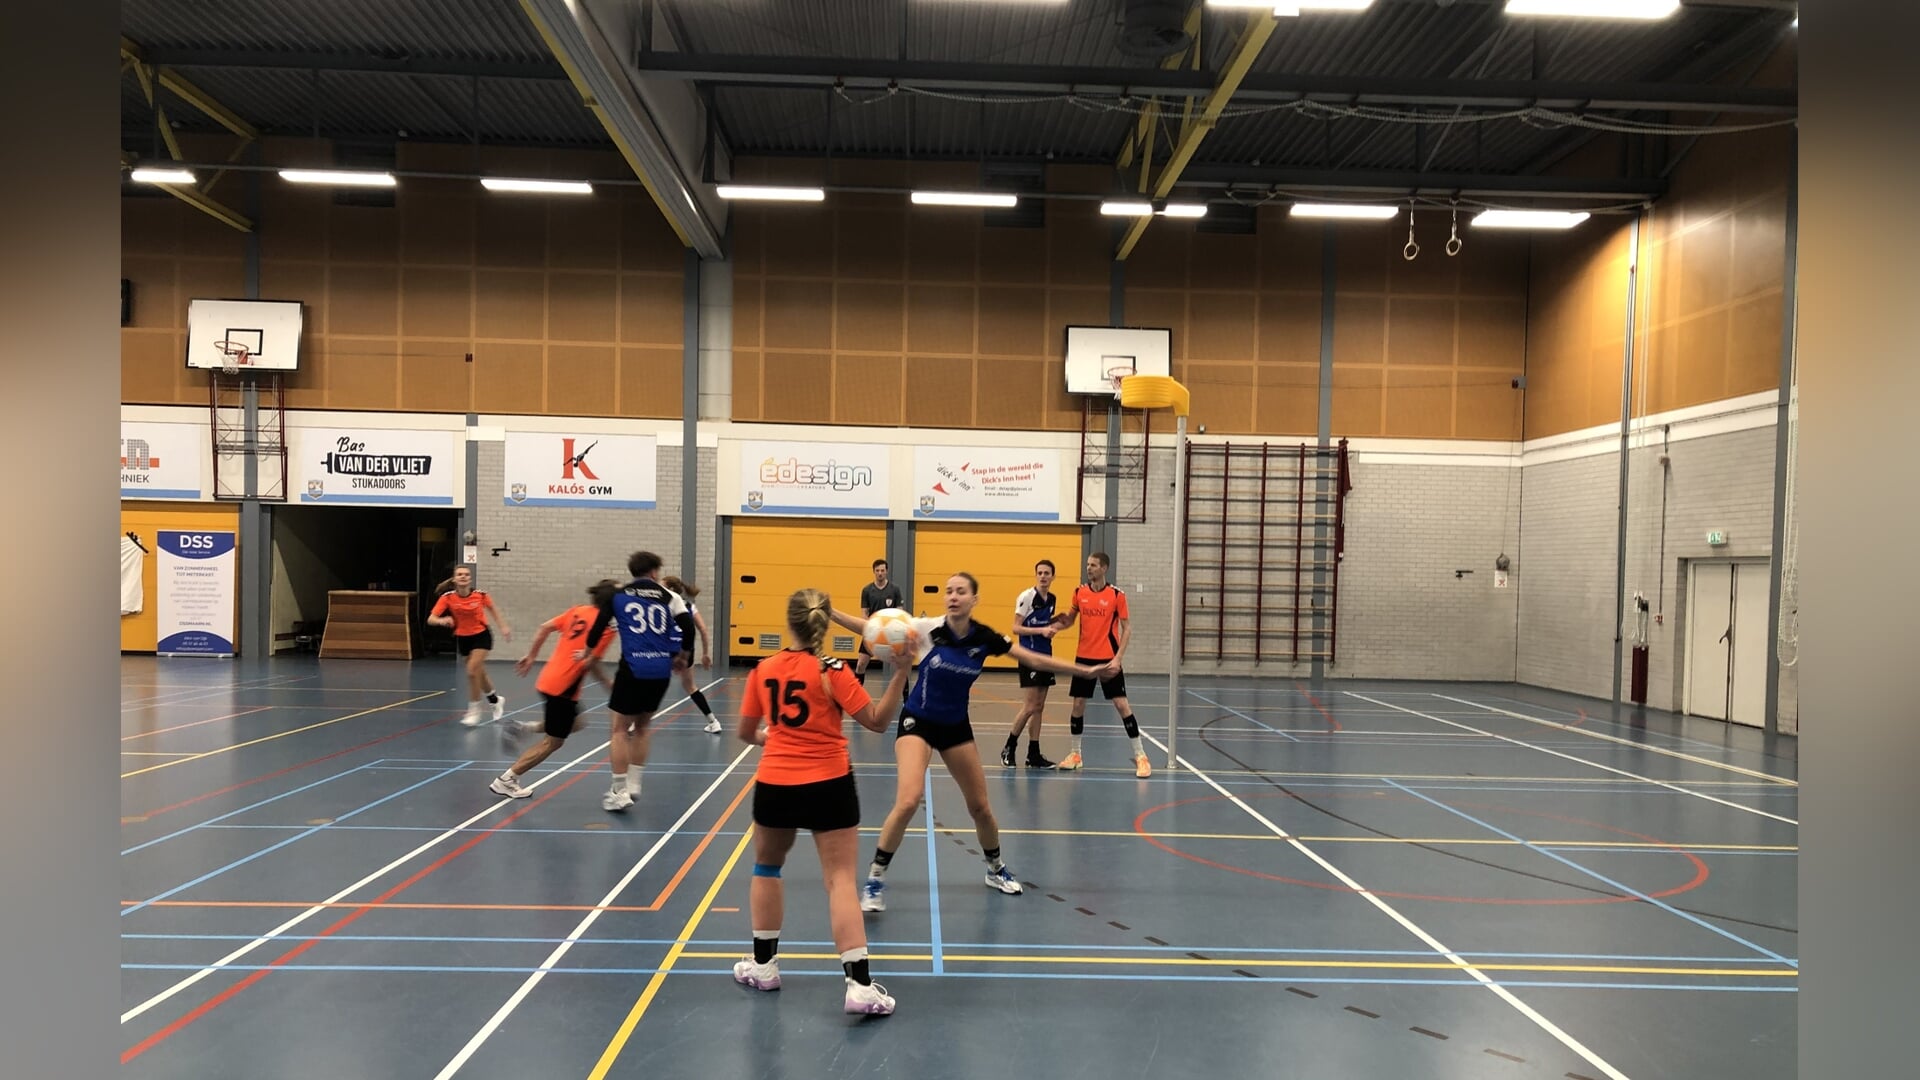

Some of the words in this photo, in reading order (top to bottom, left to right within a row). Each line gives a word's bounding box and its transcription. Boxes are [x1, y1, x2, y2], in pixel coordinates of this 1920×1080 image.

[336, 436, 366, 453] Bas
[338, 456, 363, 472] VAN
[366, 457, 390, 473] DER
[392, 457, 426, 474] VLIET
[997, 465, 1006, 473] de
[1007, 463, 1032, 472] wereld
[1032, 462, 1044, 470] die
[761, 457, 872, 491] édesign
[352, 478, 406, 489] STUKADOORS
[548, 483, 585, 494] KALÓS
[589, 486, 612, 495] GYM
[179, 535, 214, 549] DSS
[624, 602, 668, 635] 30
[764, 678, 810, 728] 15
